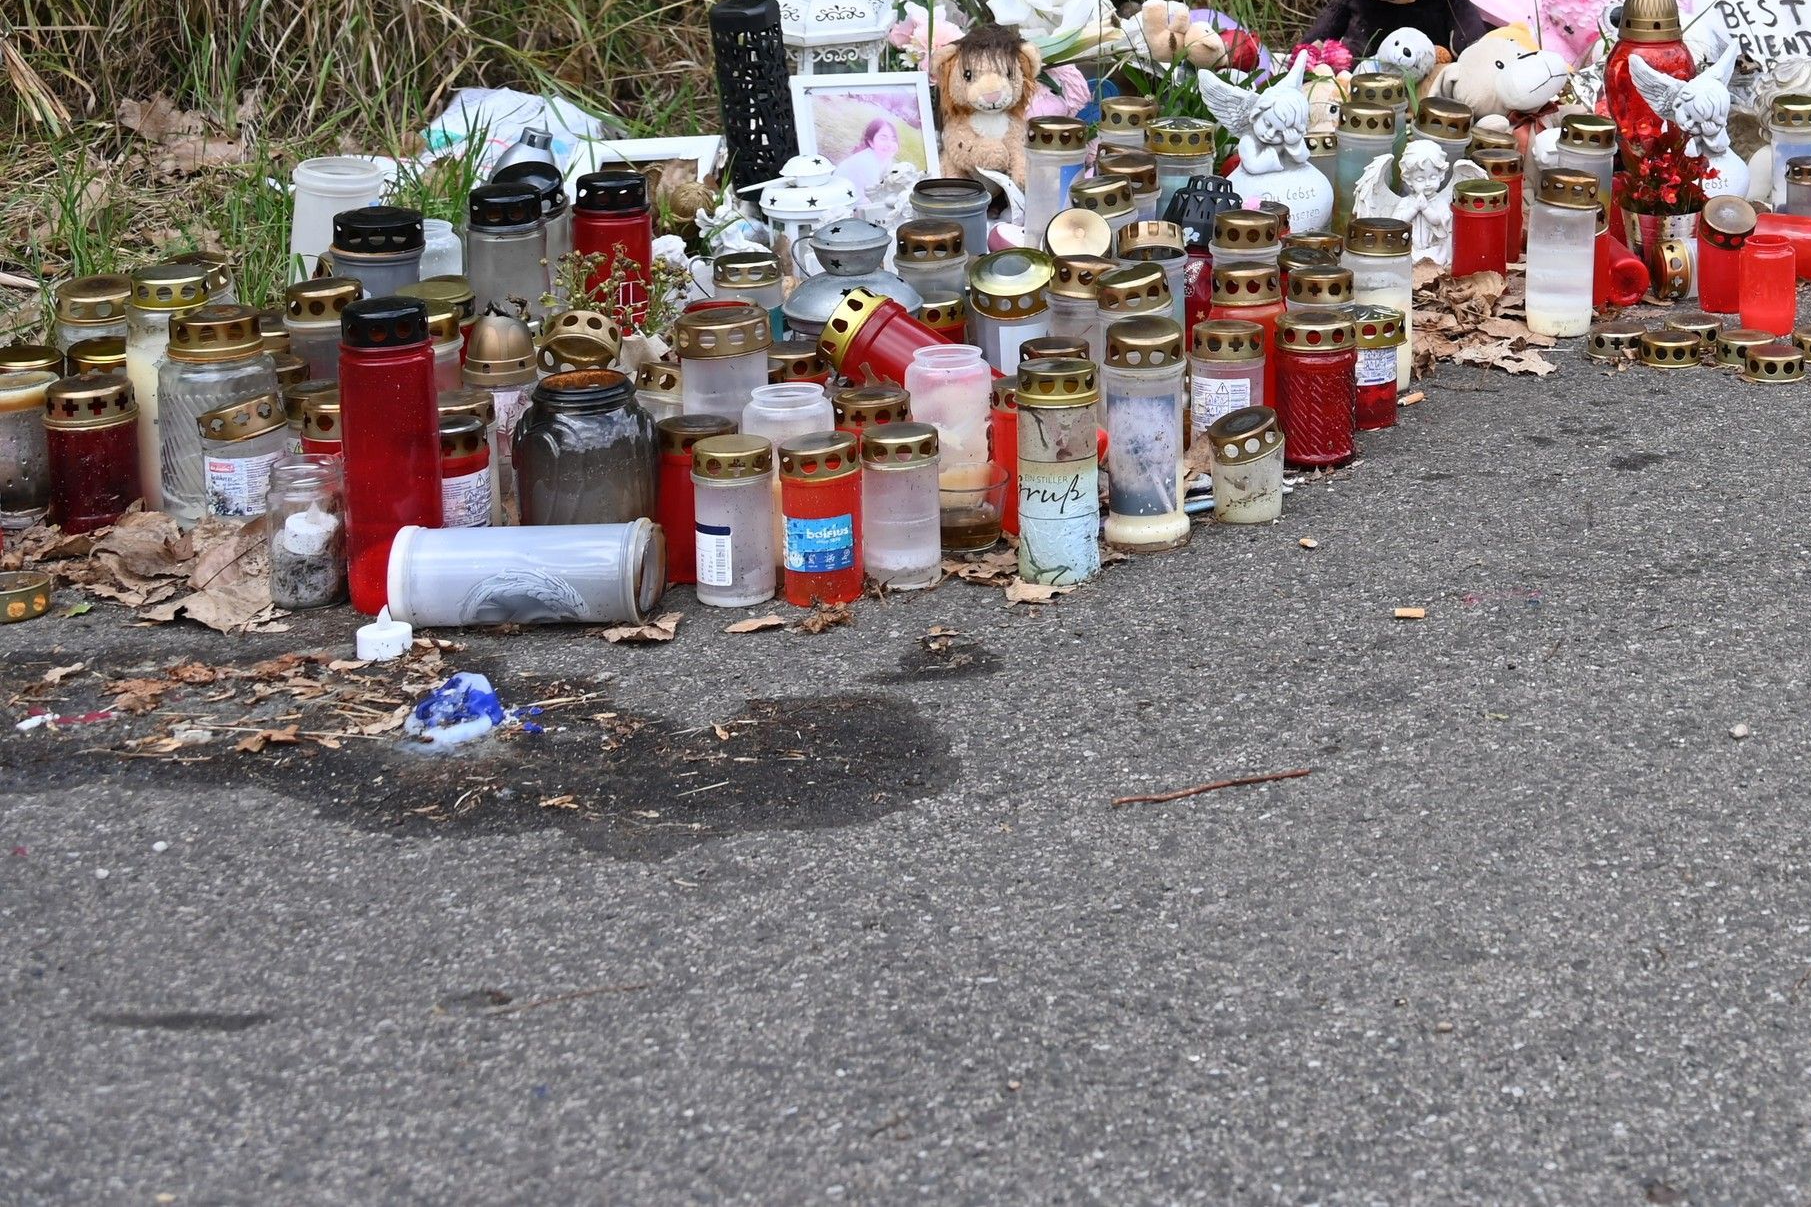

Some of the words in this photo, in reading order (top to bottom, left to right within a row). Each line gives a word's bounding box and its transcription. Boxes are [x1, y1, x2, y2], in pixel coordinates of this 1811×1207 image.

[1714, 0, 1806, 29] BEST
[1286, 186, 1317, 200] lebst
[1705, 178, 1728, 189] ebst
[1019, 474, 1086, 514] ruß
